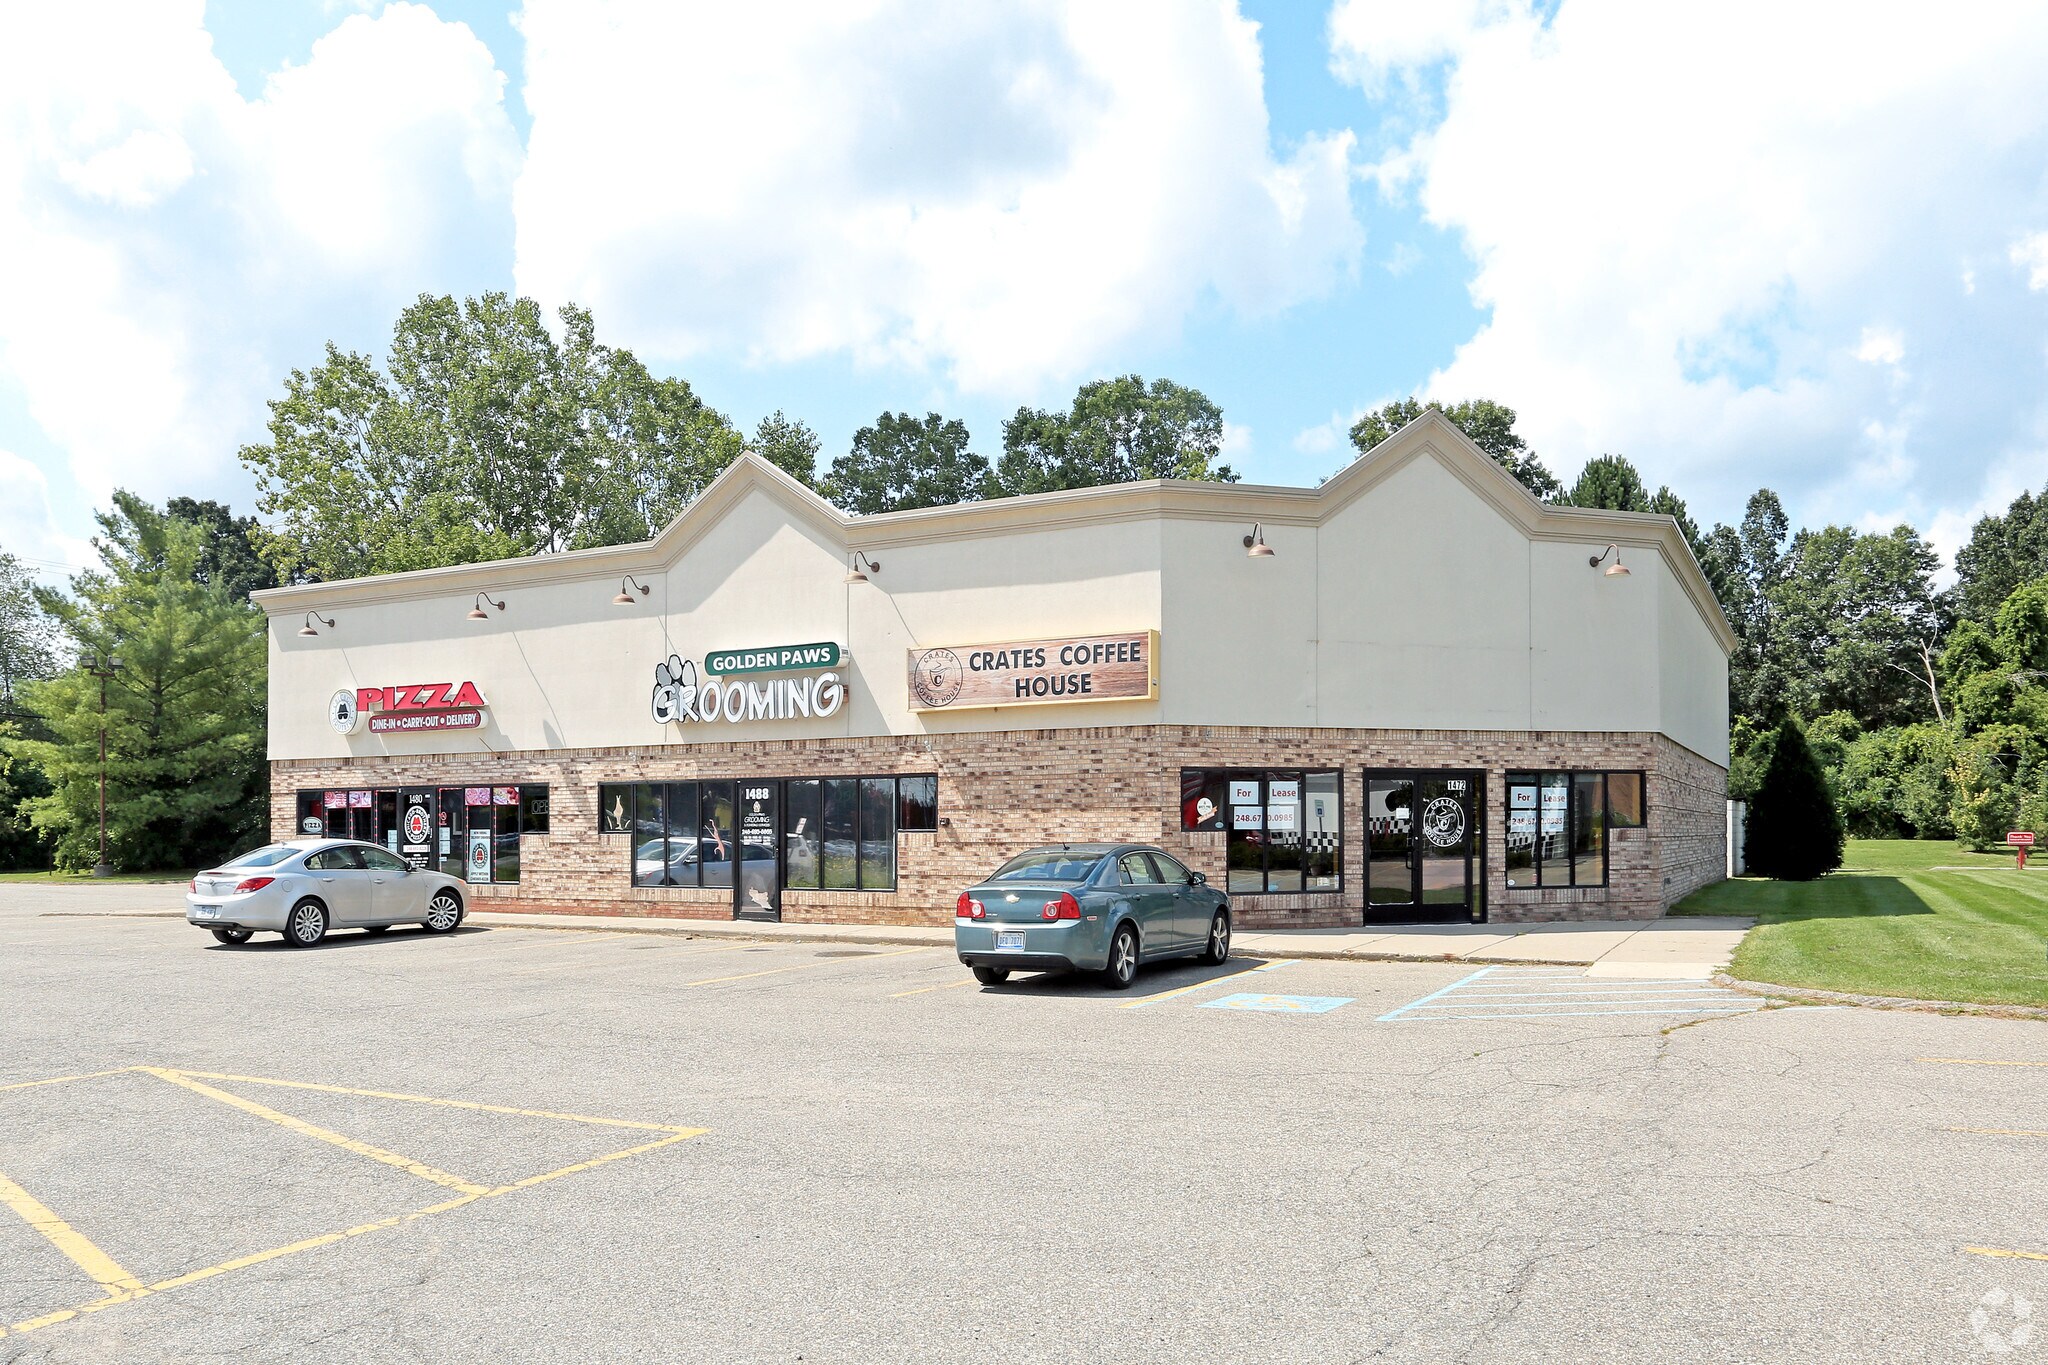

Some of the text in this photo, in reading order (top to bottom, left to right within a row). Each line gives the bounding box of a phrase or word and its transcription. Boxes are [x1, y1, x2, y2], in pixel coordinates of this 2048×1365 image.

[713, 647, 831, 671] GOLDEN PAWS
[924, 651, 954, 664] CRATES
[969, 641, 1141, 672] CRATES COFFEE
[934, 675, 942, 684] C
[1015, 673, 1092, 698] HOUSE
[356, 681, 485, 711] PIZZA
[652, 672, 844, 725] GROOMING
[917, 681, 961, 704] COFFEE HOUSE
[372, 713, 477, 730] DINE-IN CARRY-OUT DELIVERY
[745, 788, 769, 800] 1488
[1236, 788, 1296, 797] For Lease
[1517, 793, 1565, 802] For Lease
[1430, 799, 1458, 810] CRATES
[1425, 826, 1445, 845] COFFEE
